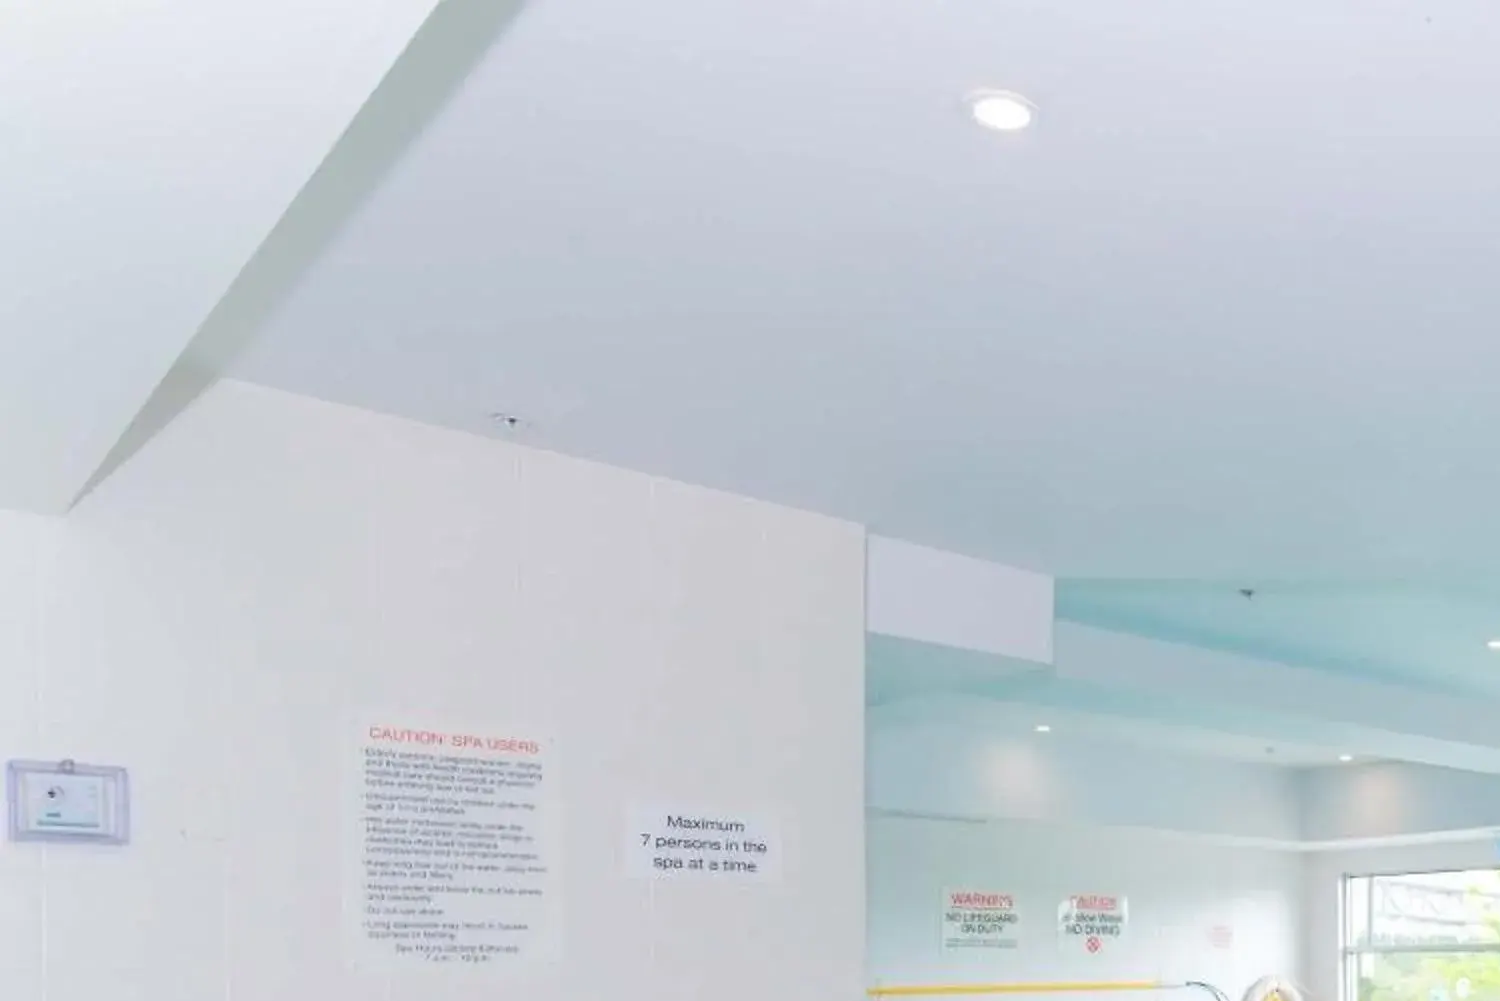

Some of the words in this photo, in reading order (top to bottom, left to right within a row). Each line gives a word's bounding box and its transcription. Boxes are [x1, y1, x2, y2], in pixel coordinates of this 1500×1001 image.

[451, 734, 483, 749] SPA
[487, 738, 540, 754] USERS
[666, 815, 746, 833] Maximum
[640, 833, 651, 847] 7
[655, 835, 721, 852] persons
[725, 839, 739, 851] in
[743, 839, 768, 853] the
[652, 857, 683, 871] spa
[687, 858, 704, 870] at
[708, 860, 719, 871] a
[723, 859, 758, 873] time
[945, 912, 962, 922] NO
[963, 913, 1019, 924] LIFEGUARD
[961, 923, 976, 934] ON
[977, 923, 1005, 935] DUTY
[1065, 923, 1083, 935] NO
[1085, 924, 1121, 937] DIVING
